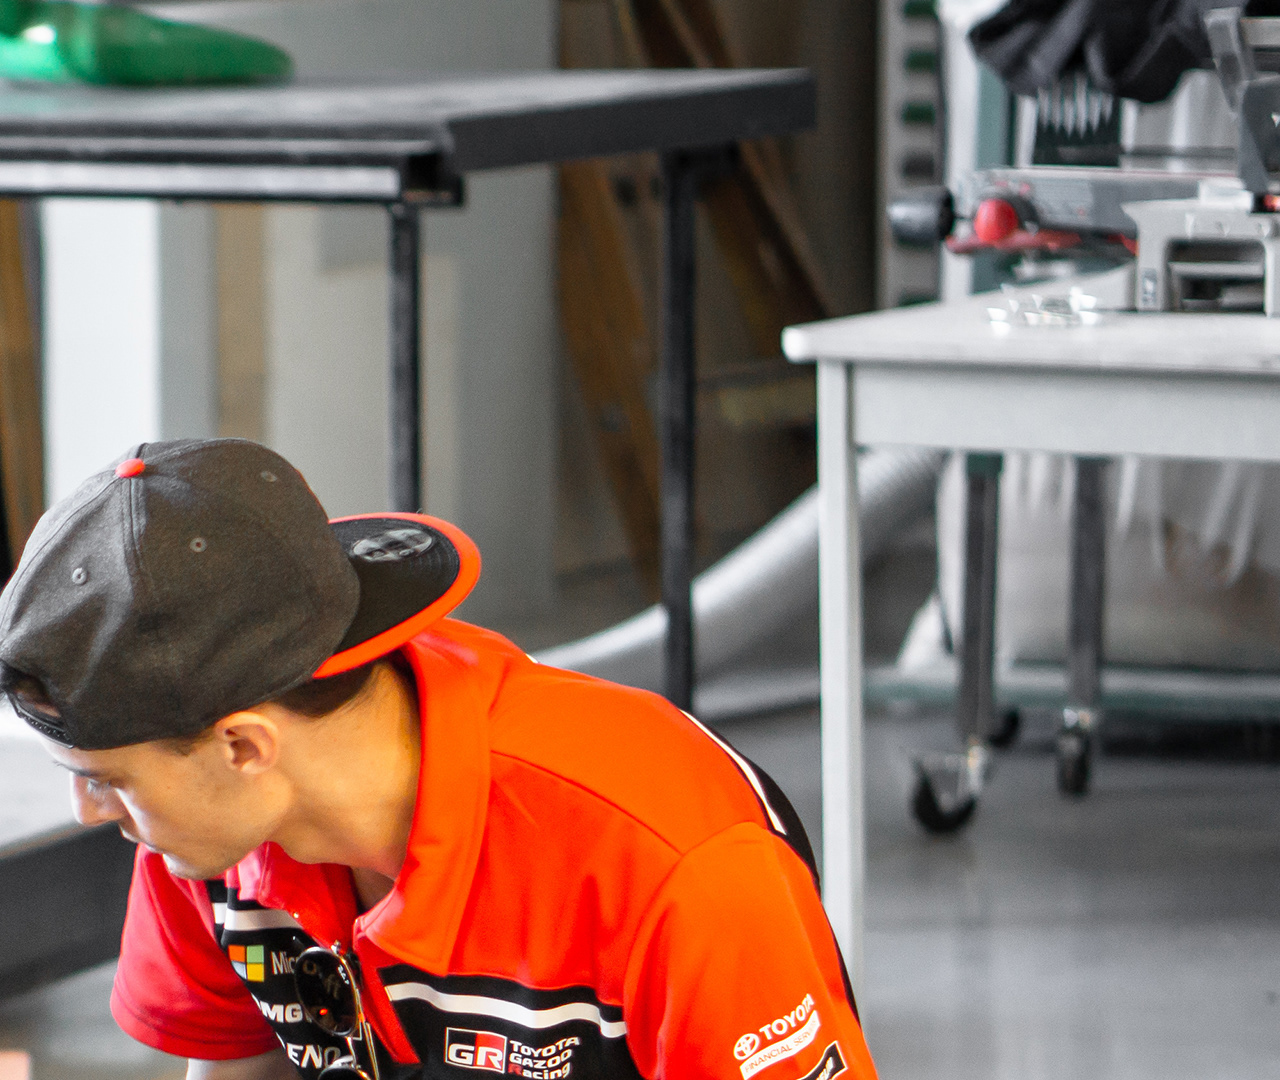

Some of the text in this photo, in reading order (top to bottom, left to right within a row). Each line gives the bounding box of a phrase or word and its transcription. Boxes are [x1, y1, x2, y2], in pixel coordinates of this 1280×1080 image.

[759, 993, 815, 1040] TOYOTA
[448, 1042, 504, 1070] GR
[509, 1036, 581, 1058] TOYOTA
[509, 1049, 573, 1069] GAZOO
[744, 1044, 793, 1074] FINANCIAL
[508, 1062, 571, 1080] Racing
